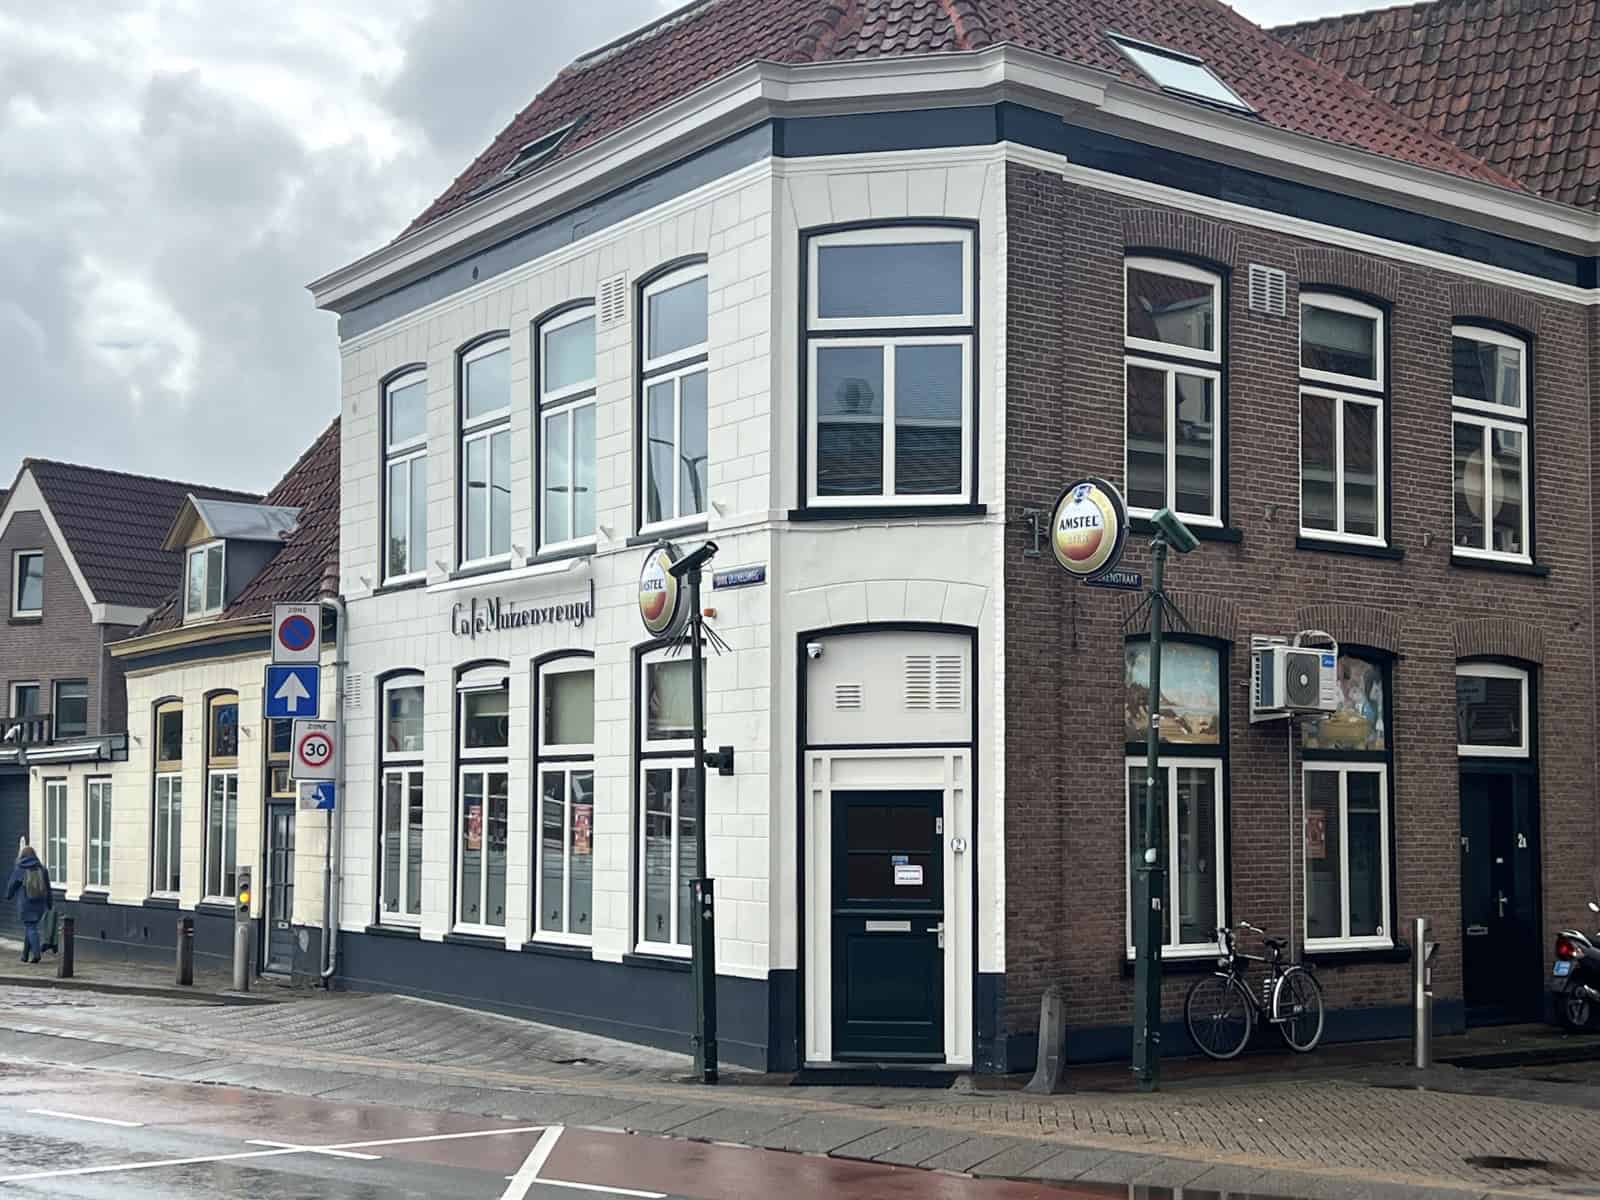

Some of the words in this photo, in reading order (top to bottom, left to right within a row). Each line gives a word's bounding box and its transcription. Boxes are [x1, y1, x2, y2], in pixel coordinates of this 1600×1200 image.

[1059, 515, 1099, 531] AMSTEL
[452, 597, 484, 640] Café
[486, 577, 595, 633] Muizenvreugd
[304, 743, 328, 757] 30
